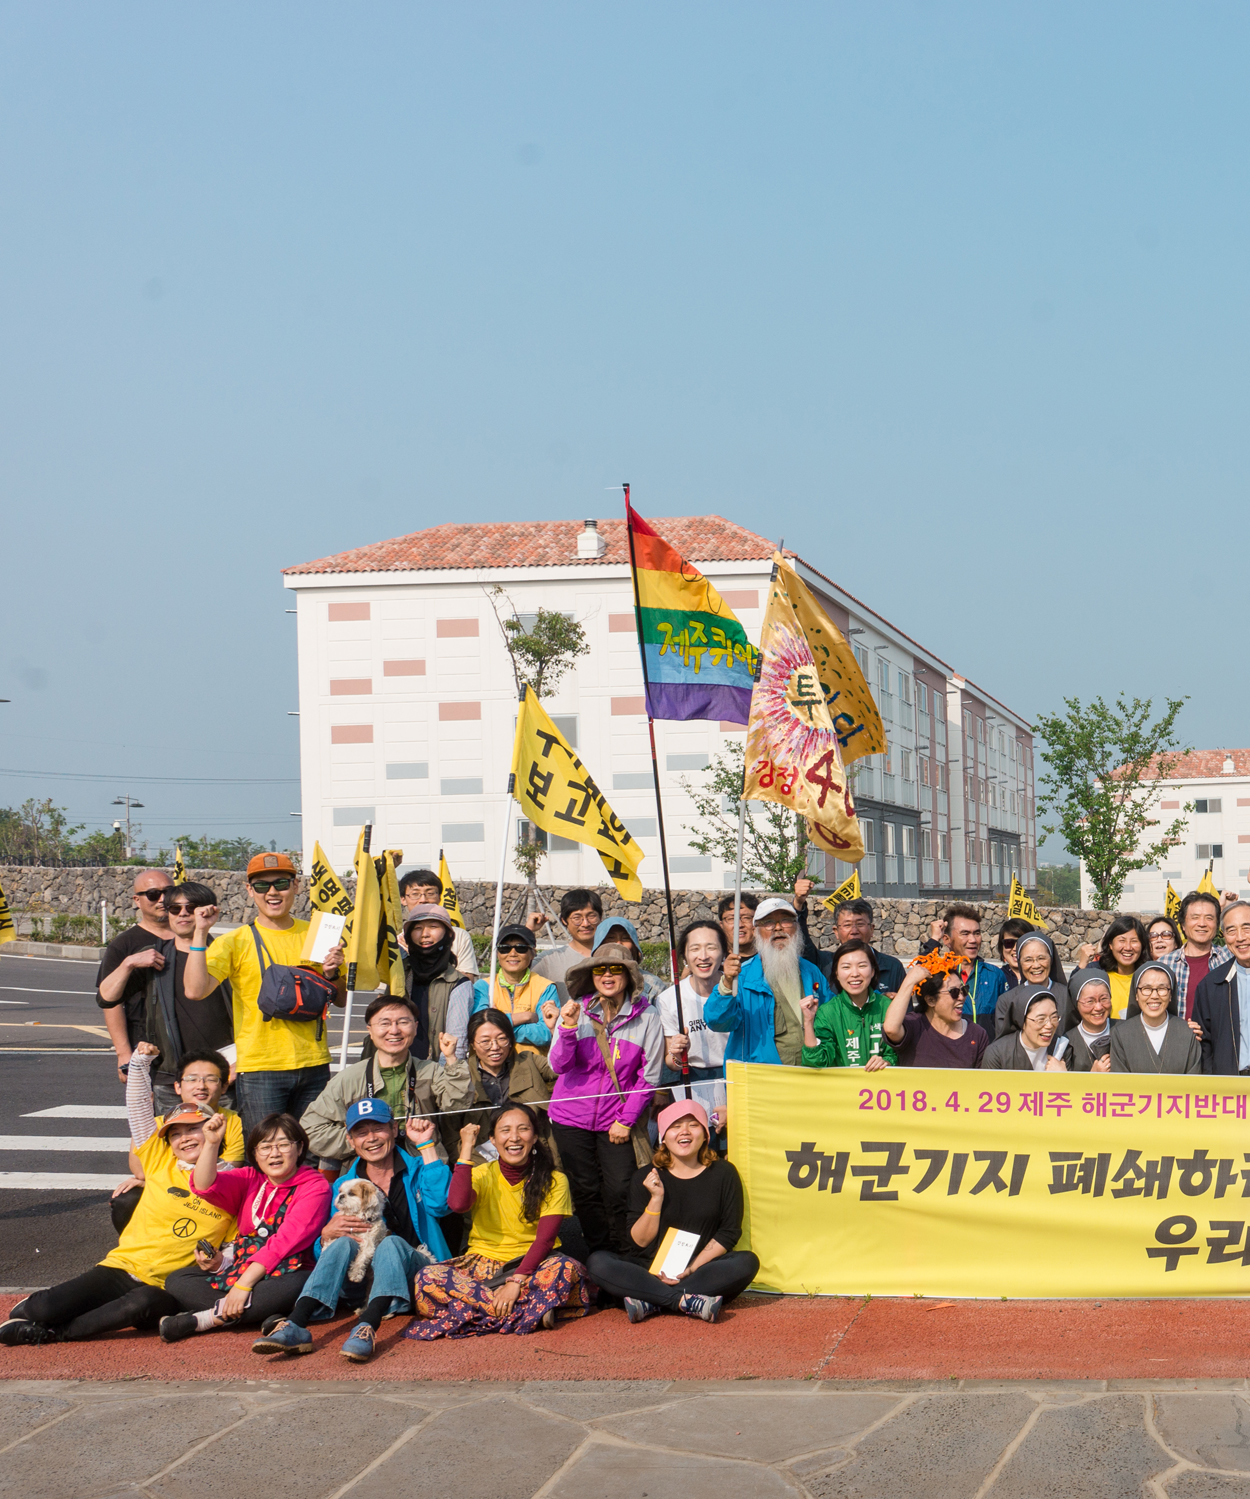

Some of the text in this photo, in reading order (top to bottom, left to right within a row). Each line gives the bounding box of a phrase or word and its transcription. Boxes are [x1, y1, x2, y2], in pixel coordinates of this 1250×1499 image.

[657, 620, 759, 676] 제주퀴어
[756, 759, 799, 796] 강정
[689, 1018, 706, 1027] GIRL
[846, 1036, 861, 1067] 제주
[358, 1100, 373, 1115] B
[858, 1088, 937, 1112] 2018.
[945, 1091, 970, 1113] 4.
[978, 1091, 1011, 1113] 29
[1018, 1091, 1073, 1117] 제주
[1081, 1092, 1248, 1119] 해군기지반대
[785, 1141, 1030, 1202] 해군기지
[183, 1202, 222, 1220] JEJU ISLAND
